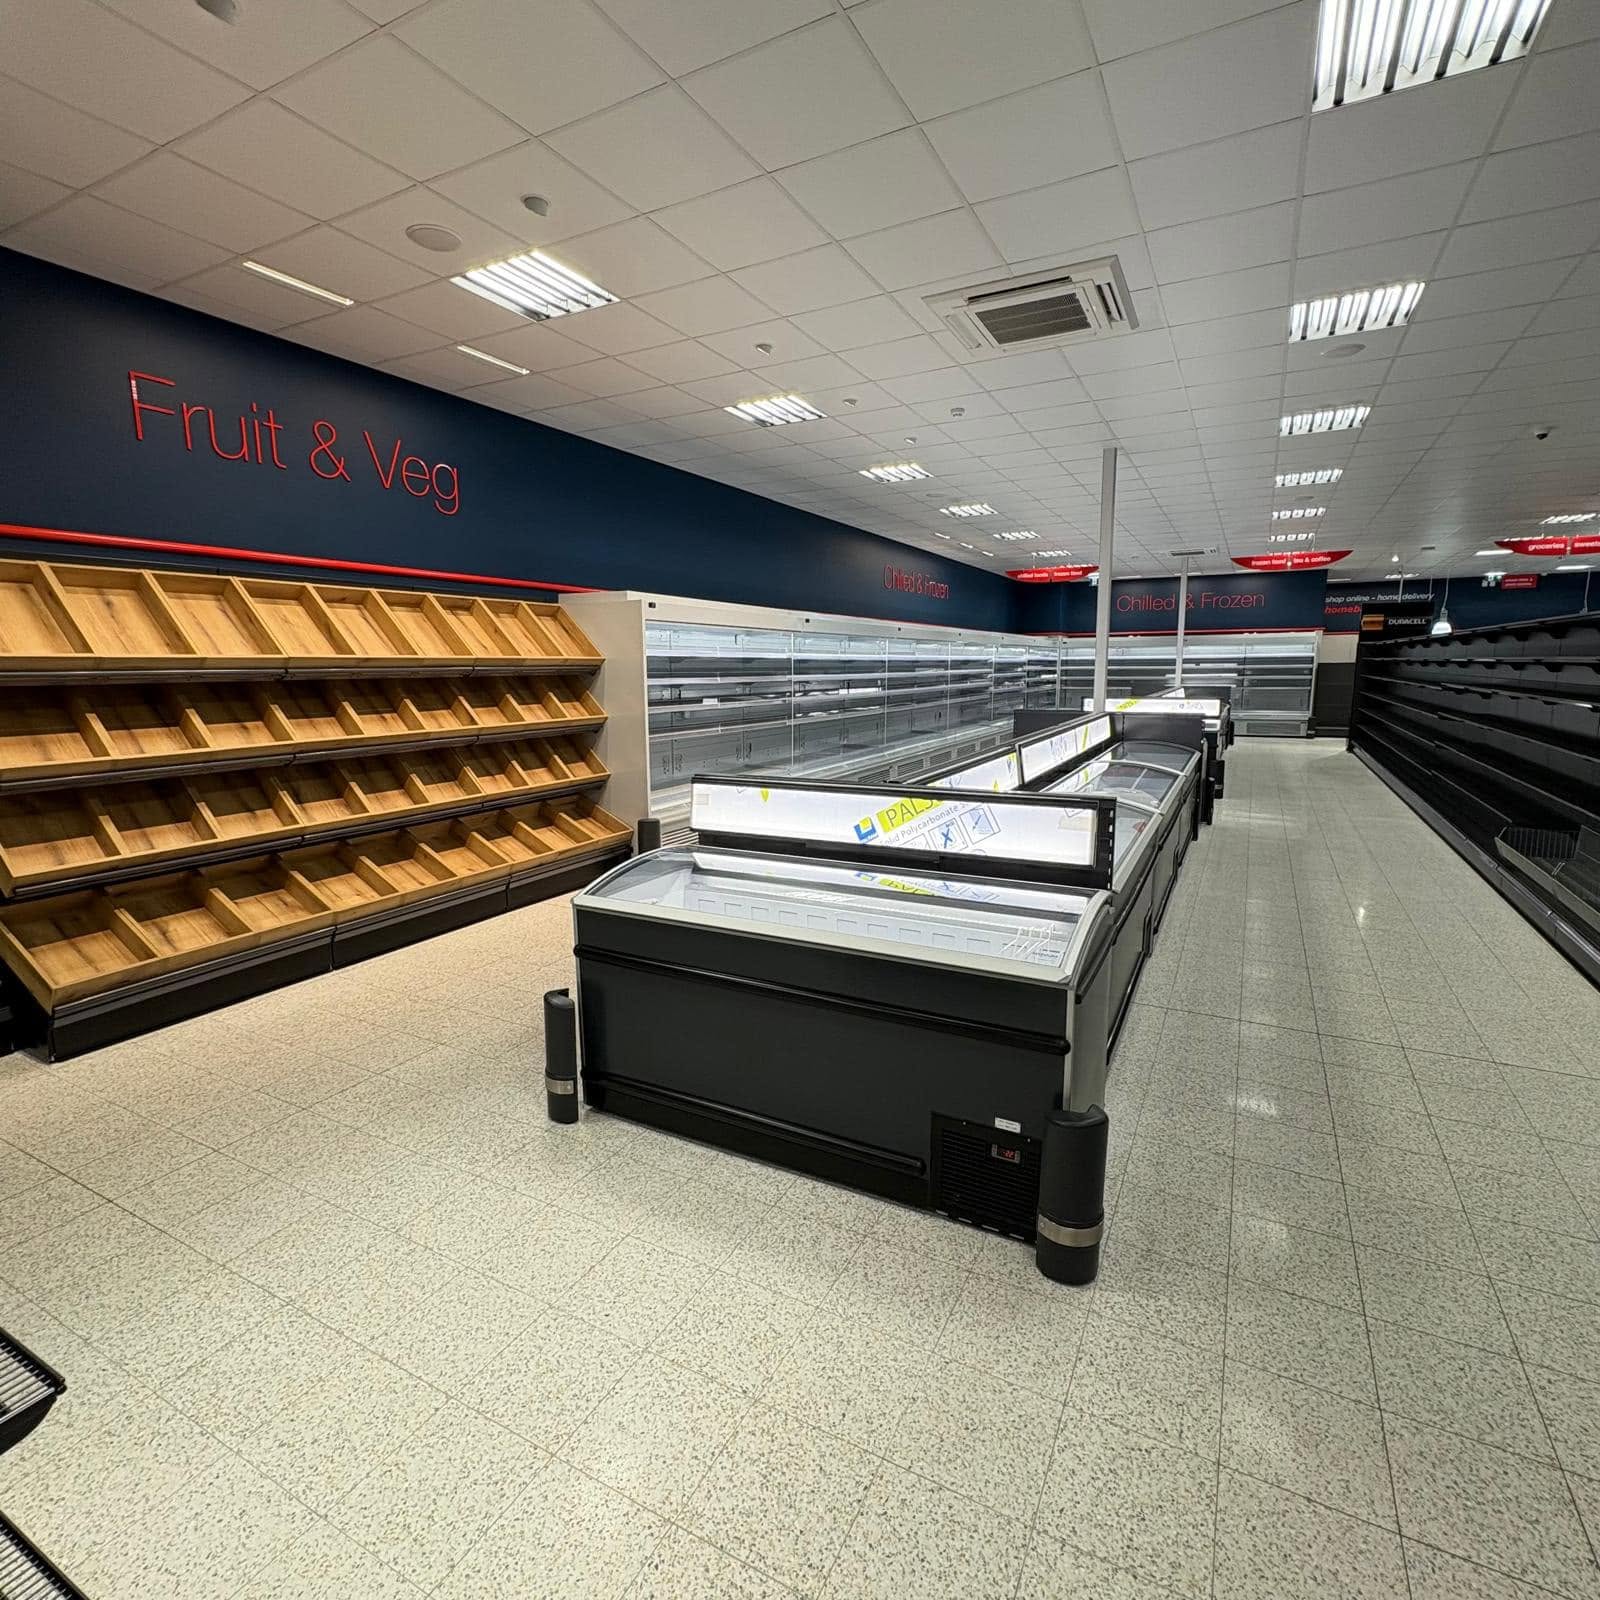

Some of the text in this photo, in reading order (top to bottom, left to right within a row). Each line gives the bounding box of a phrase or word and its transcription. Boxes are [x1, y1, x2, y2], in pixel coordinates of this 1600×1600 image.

[128, 370, 461, 516] Fruit & Veg
[1528, 543, 1565, 552] groceries
[1116, 592, 1265, 612] Chilled & Frozen
[1325, 594, 1345, 604] shop
[1346, 594, 1370, 602] online
[1377, 593, 1400, 601] home
[1401, 592, 1435, 602] delivery
[901, 805, 959, 837] Polycarbonate
